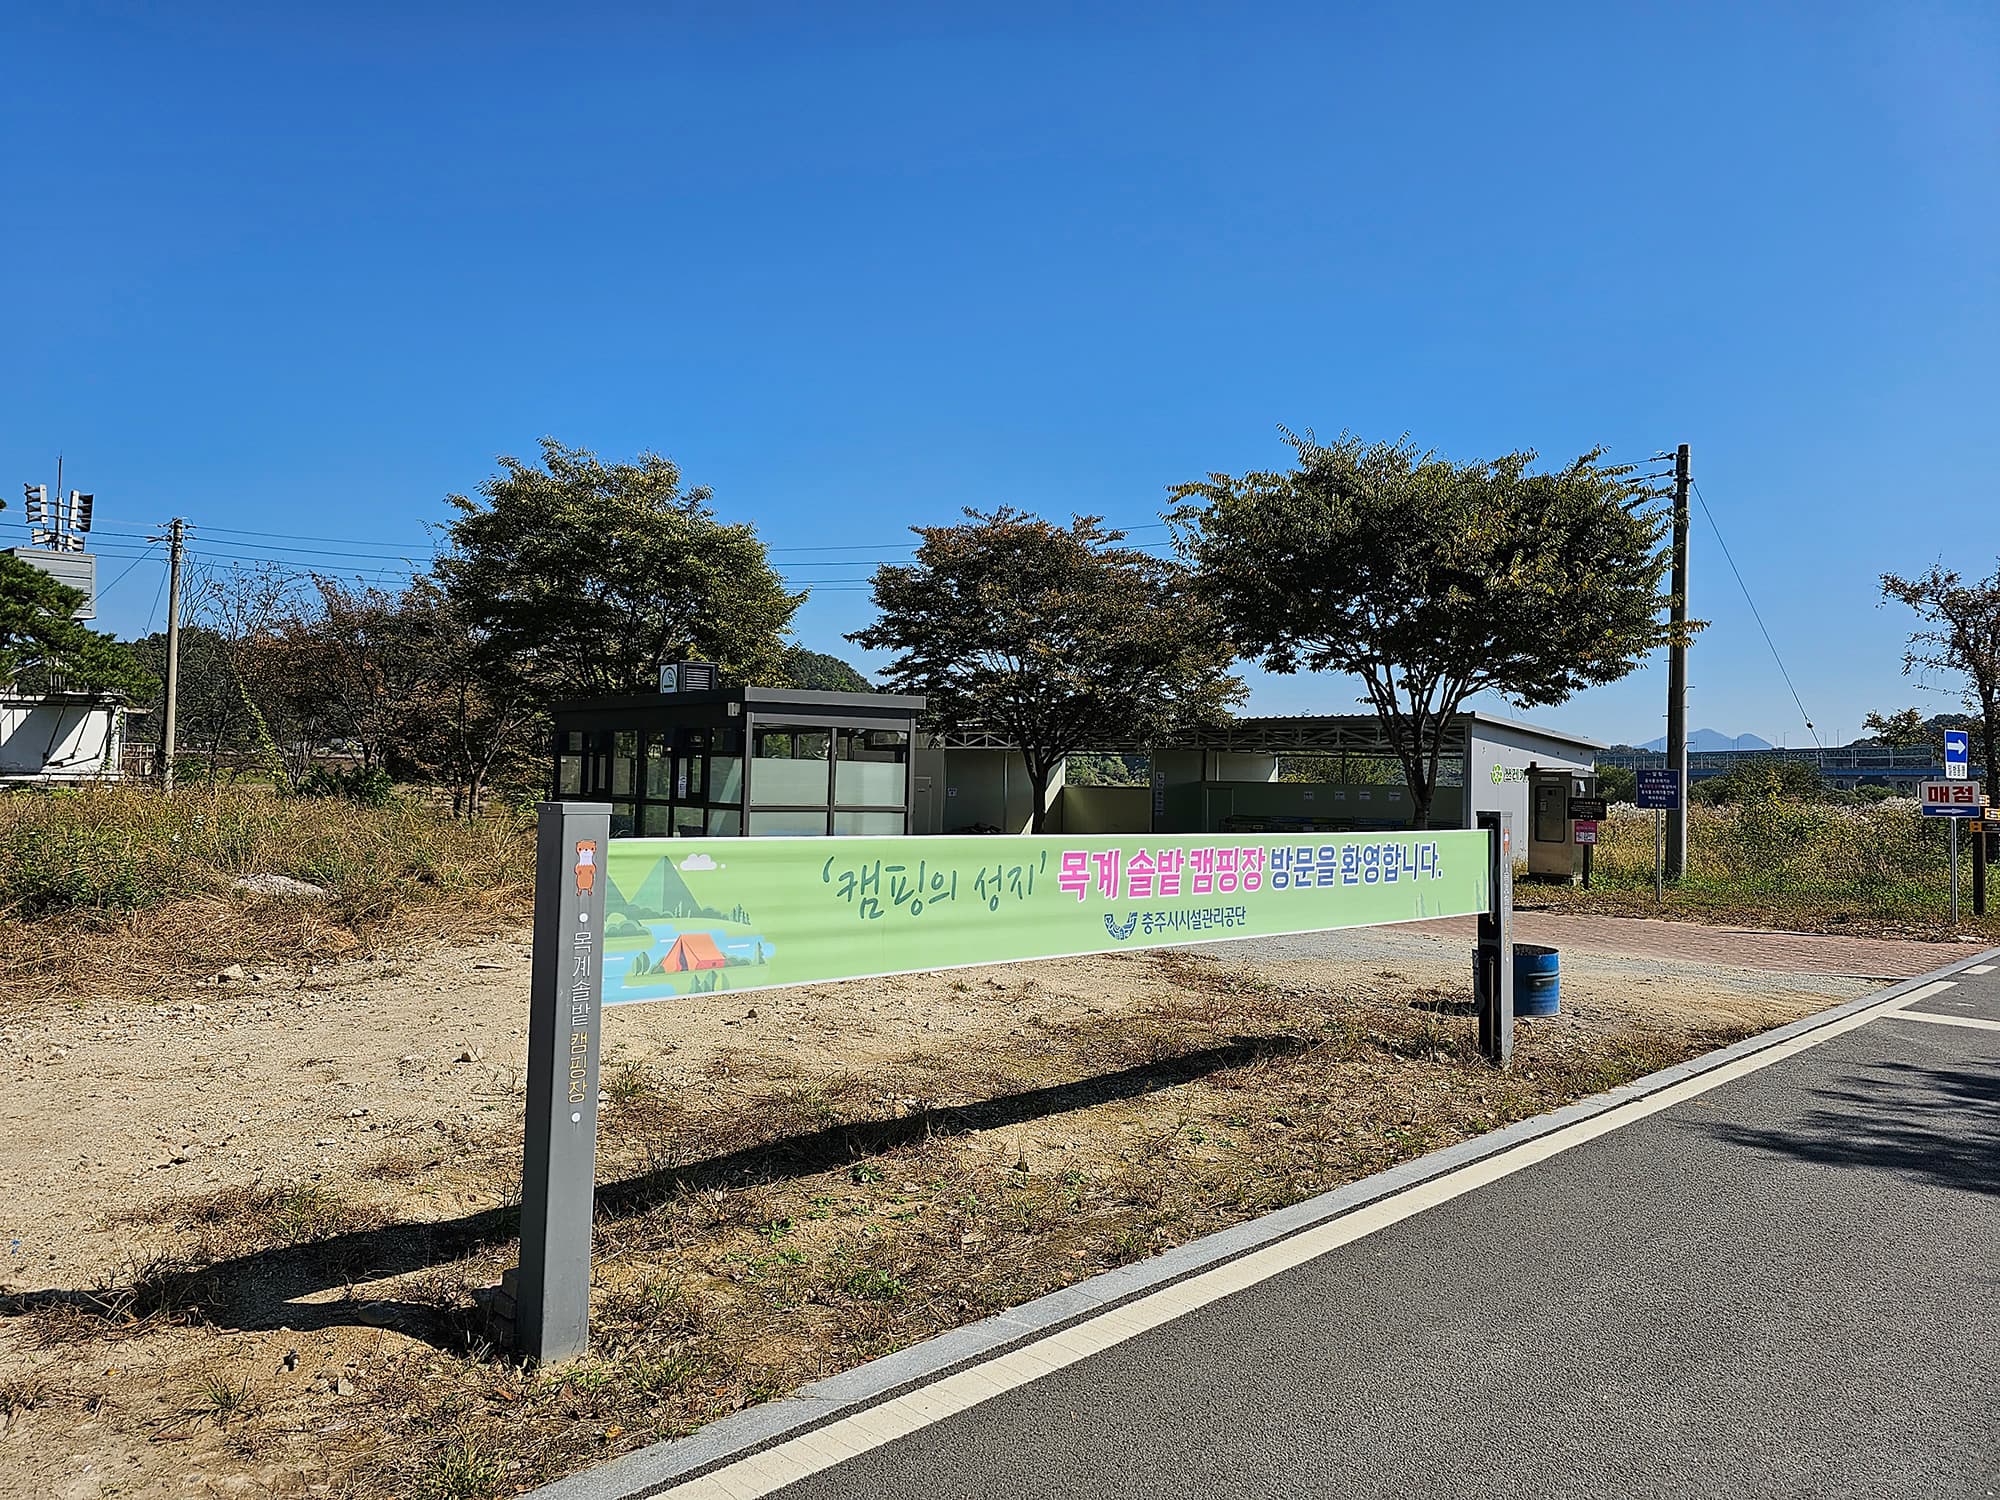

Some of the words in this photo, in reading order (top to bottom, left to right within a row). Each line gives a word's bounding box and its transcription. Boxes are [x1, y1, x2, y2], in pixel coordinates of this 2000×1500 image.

[1927, 785, 1974, 804] 매점
[1057, 849, 1121, 902] 목계
[1127, 848, 1185, 899] 솔밭
[1189, 846, 1267, 895] 캠핑장
[1270, 845, 1337, 890] 방문을
[1340, 841, 1443, 885] 환영합니다.
[1141, 905, 1247, 935] 충주시시설관리공단
[571, 931, 593, 1027] 목계솔밭
[568, 1031, 589, 1104] 캠핑장
